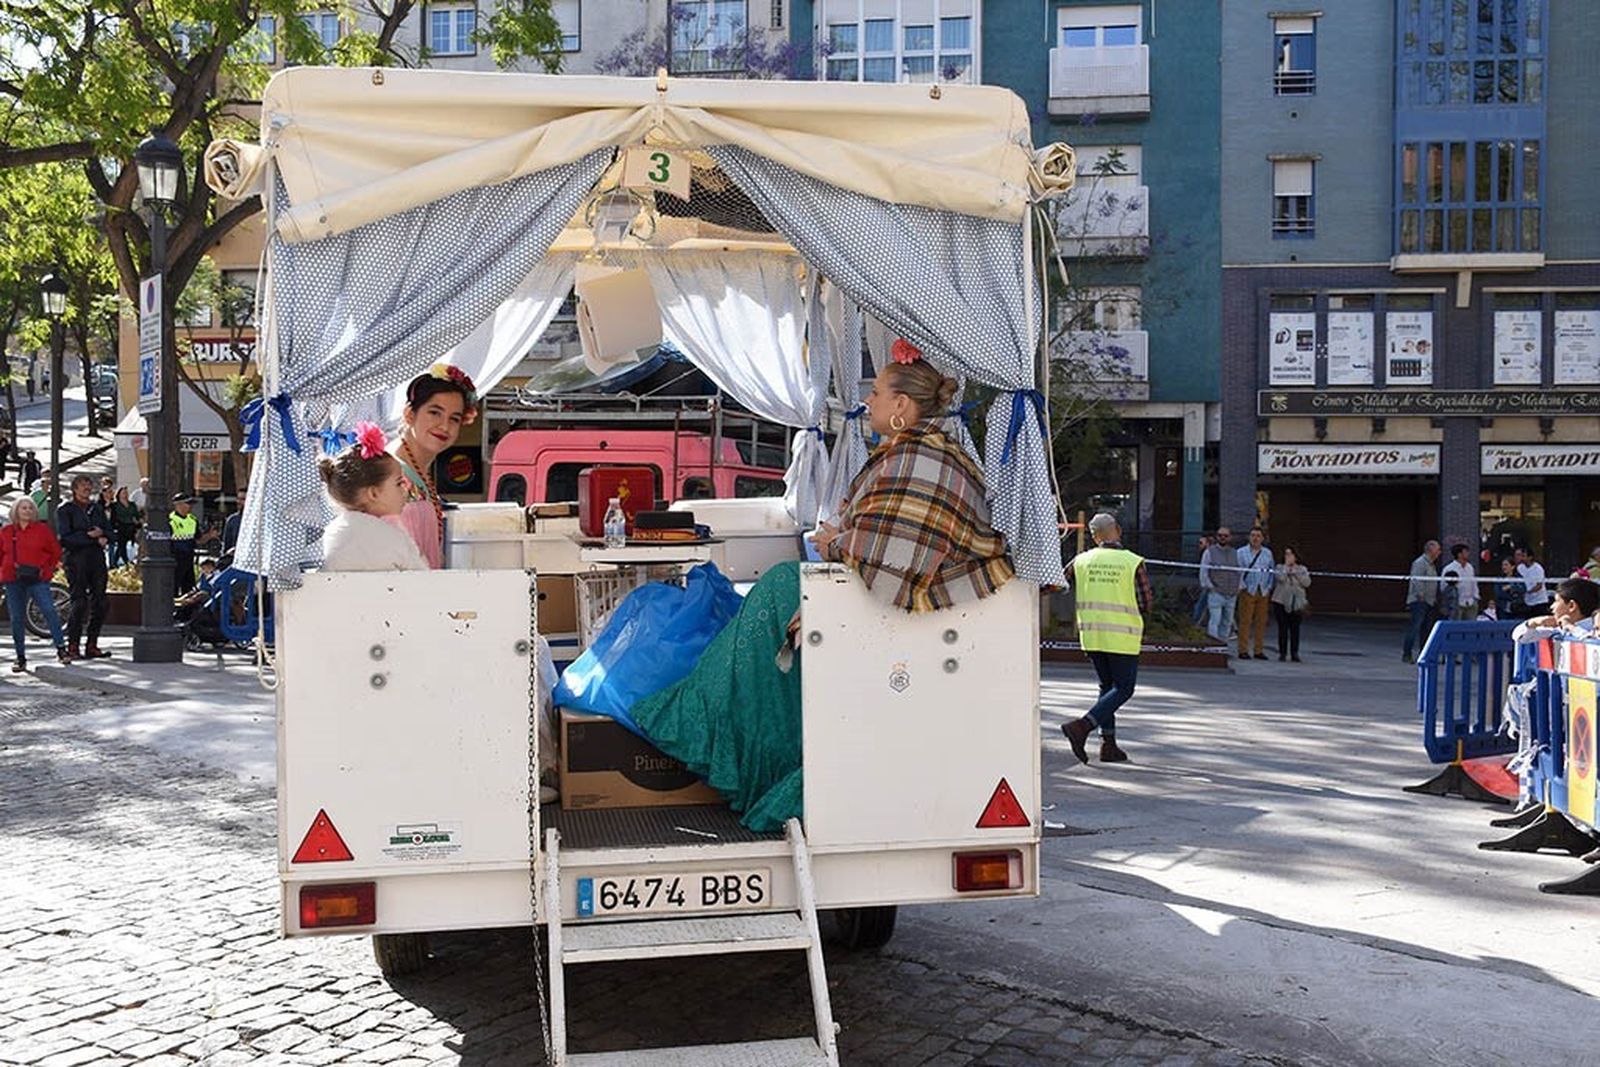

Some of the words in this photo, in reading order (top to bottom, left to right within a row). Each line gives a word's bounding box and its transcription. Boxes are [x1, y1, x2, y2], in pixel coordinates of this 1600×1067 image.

[648, 152, 670, 182] 3
[191, 342, 256, 361] BURG
[1270, 451, 1400, 469] MONTADITOS
[600, 878, 686, 910] 6474
[702, 873, 764, 906] BBS
